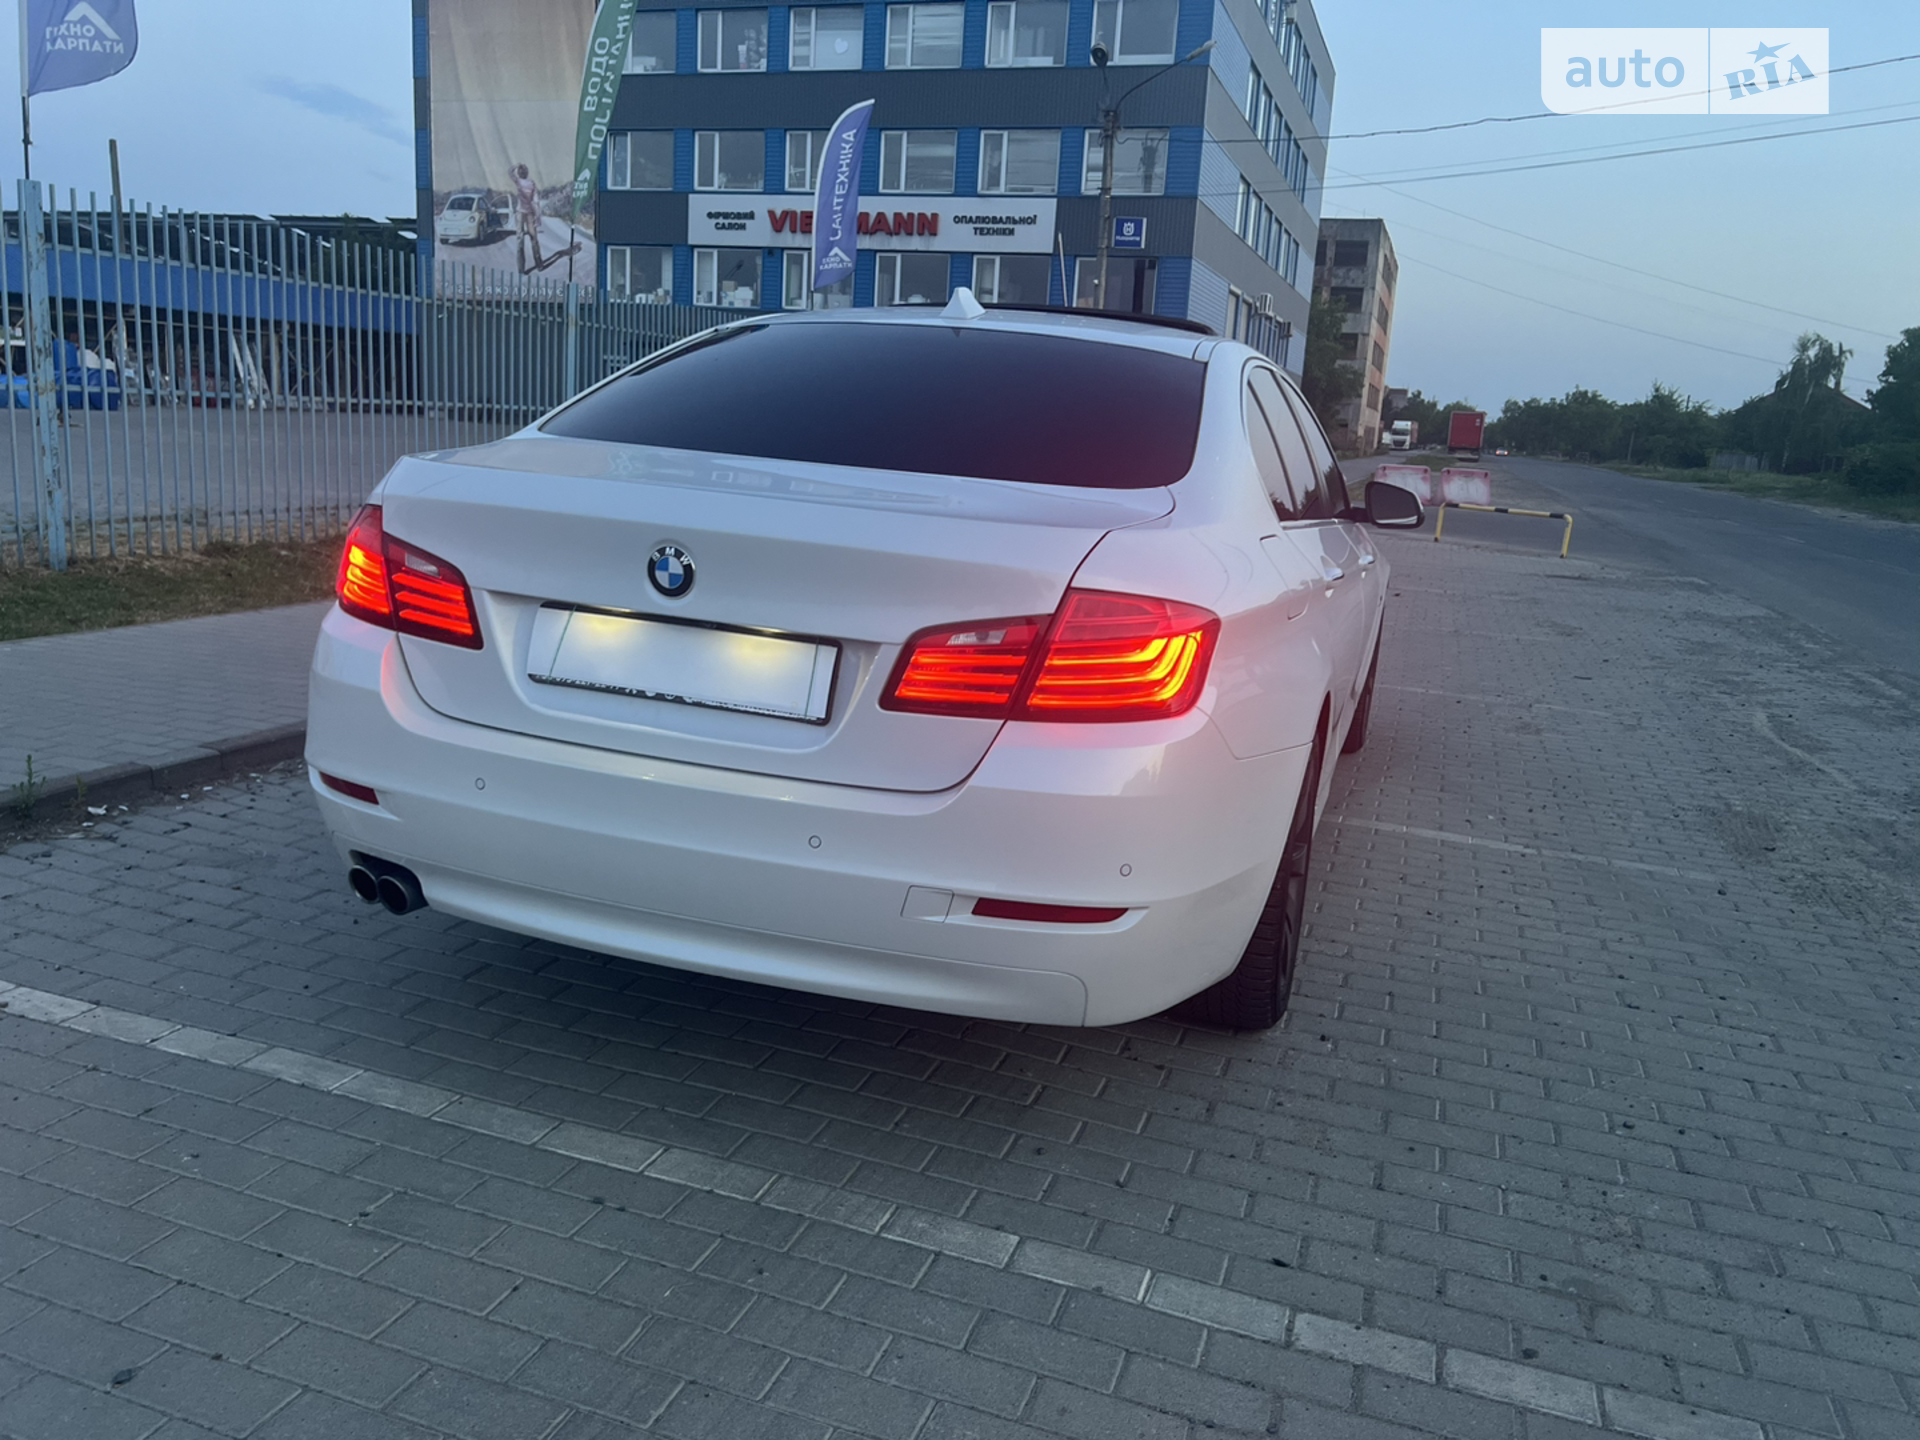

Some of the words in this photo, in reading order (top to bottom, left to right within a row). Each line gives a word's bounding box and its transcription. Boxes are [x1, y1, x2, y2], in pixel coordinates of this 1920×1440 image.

[583, 37, 610, 112] ВОДО
[714, 222, 747, 231] САЛОН
[766, 208, 940, 237] VIEMANN
[952, 214, 1037, 226] ОПАЛЮВАЛЬНОЇ
[972, 227, 1015, 236] ТЕХНІКИ
[651, 546, 691, 566] BMW
